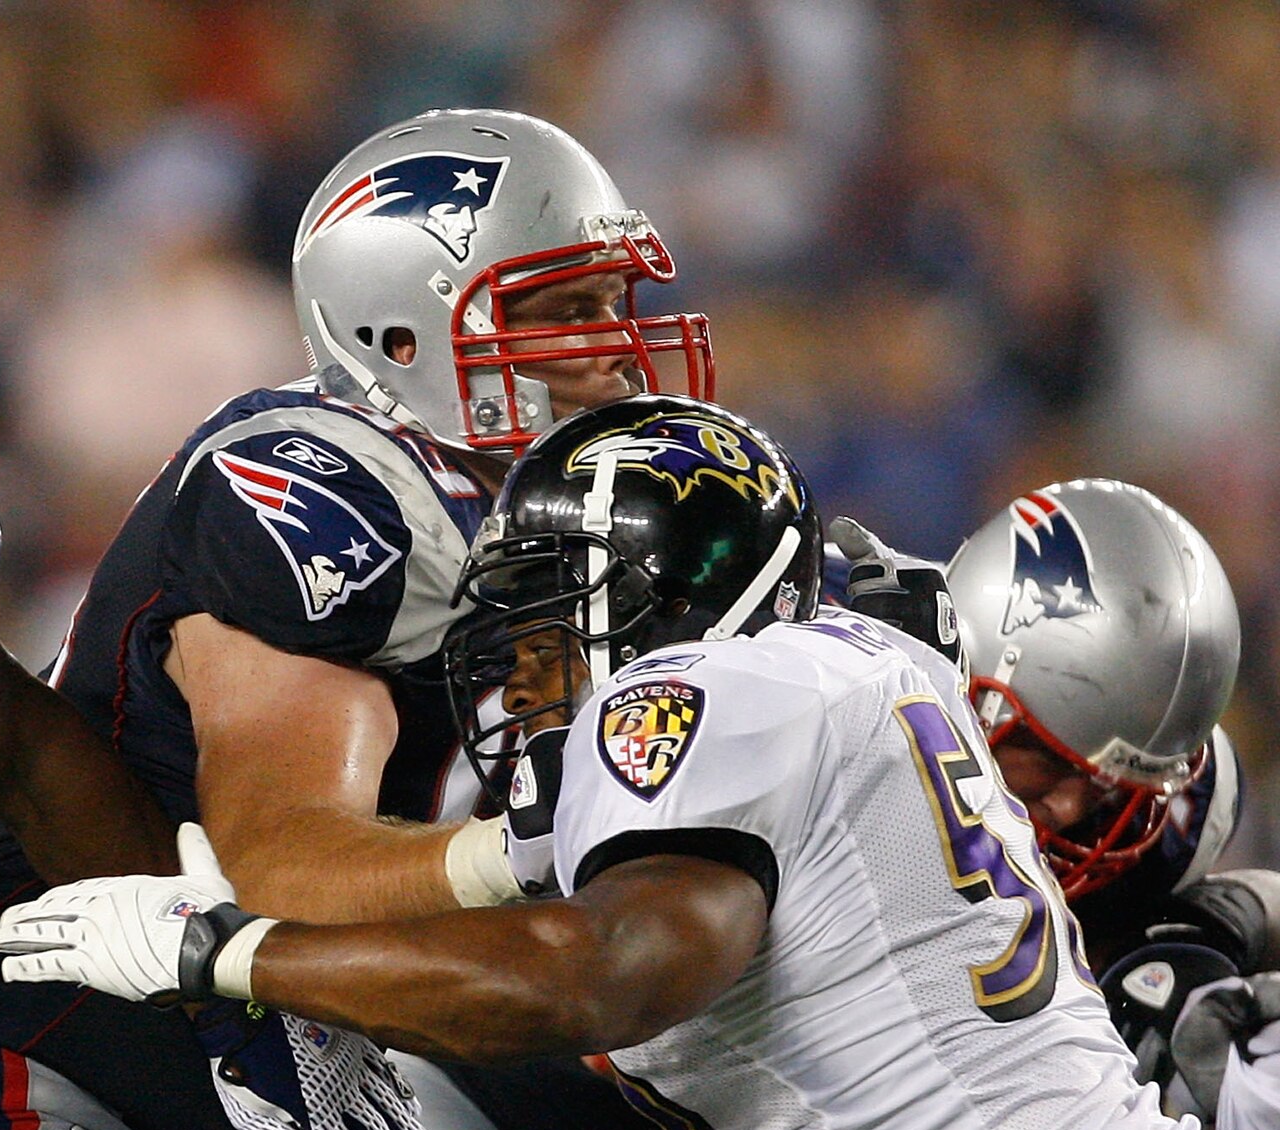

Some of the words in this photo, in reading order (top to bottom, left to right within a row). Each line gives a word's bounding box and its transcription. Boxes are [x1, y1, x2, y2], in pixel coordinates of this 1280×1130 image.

[688, 419, 751, 471] B
[607, 686, 695, 711] RAVENS
[611, 704, 649, 737] B
[892, 693, 1106, 1023] 5
